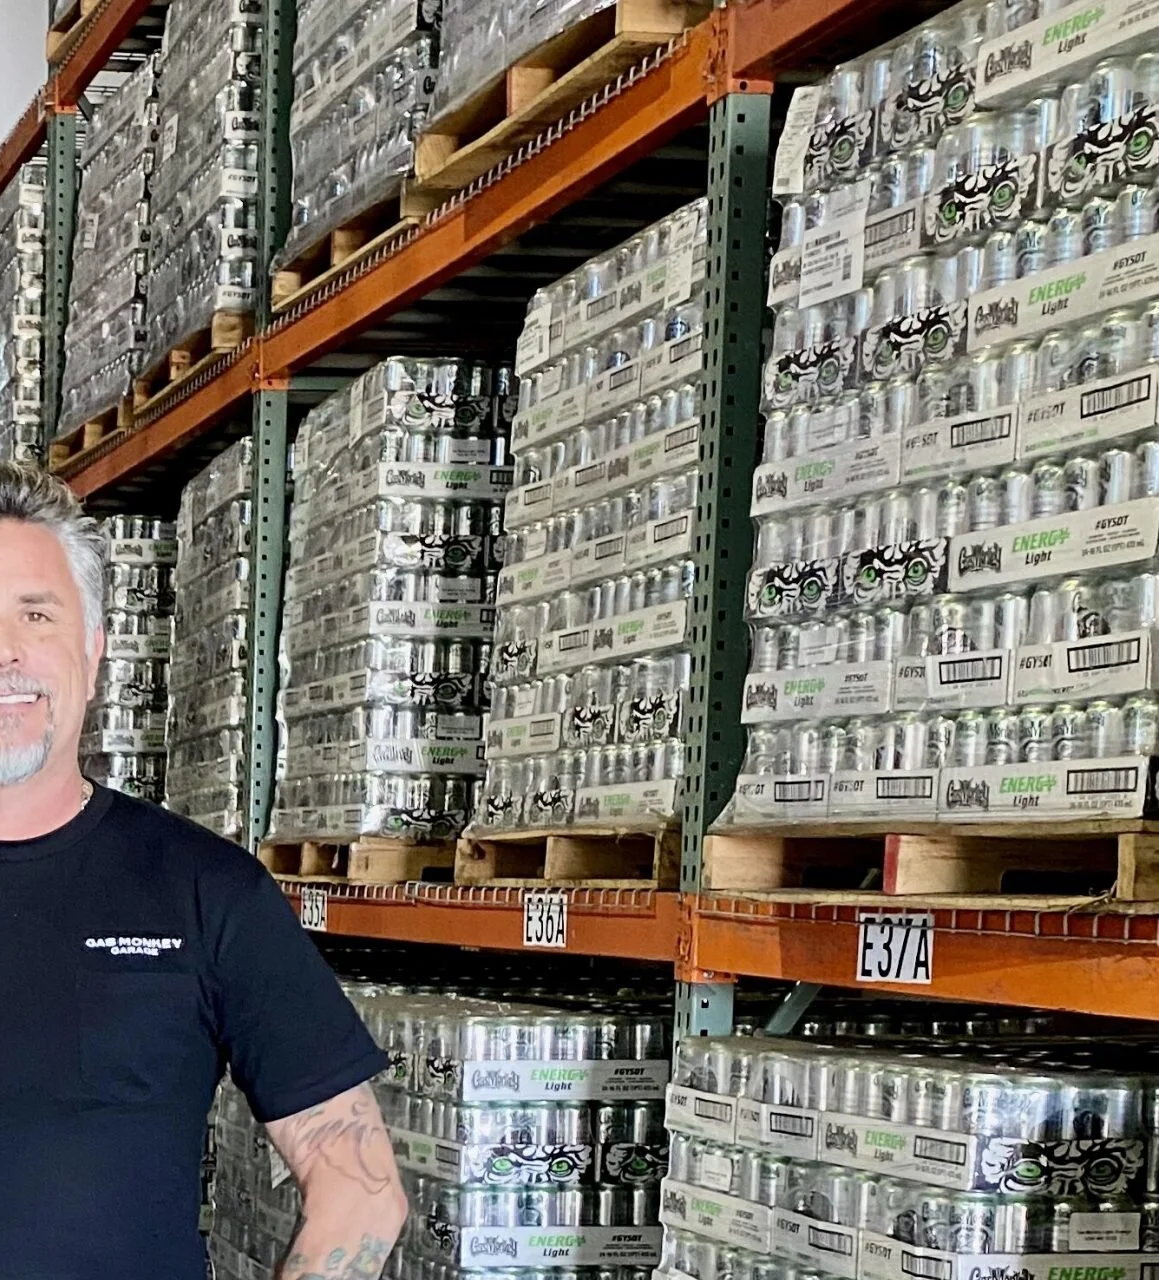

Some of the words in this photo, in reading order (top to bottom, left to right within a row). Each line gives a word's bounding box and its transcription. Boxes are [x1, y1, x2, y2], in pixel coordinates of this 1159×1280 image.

[1028, 272, 1087, 305] ENERGY
[1012, 527, 1071, 553] ENERGY
[1025, 550, 1053, 566] Light
[999, 774, 1057, 794] ENERGY
[1013, 795, 1040, 809] Light
[526, 895, 565, 943] E36A
[85, 938, 117, 948] GAS
[119, 937, 183, 949] MONKEY
[861, 917, 929, 980] E37A
[110, 946, 159, 956] GARAGE
[530, 1068, 588, 1081] ENERGY
[545, 1082, 573, 1091] Light
[528, 1235, 586, 1247] ENERGY
[543, 1248, 570, 1257] Light
